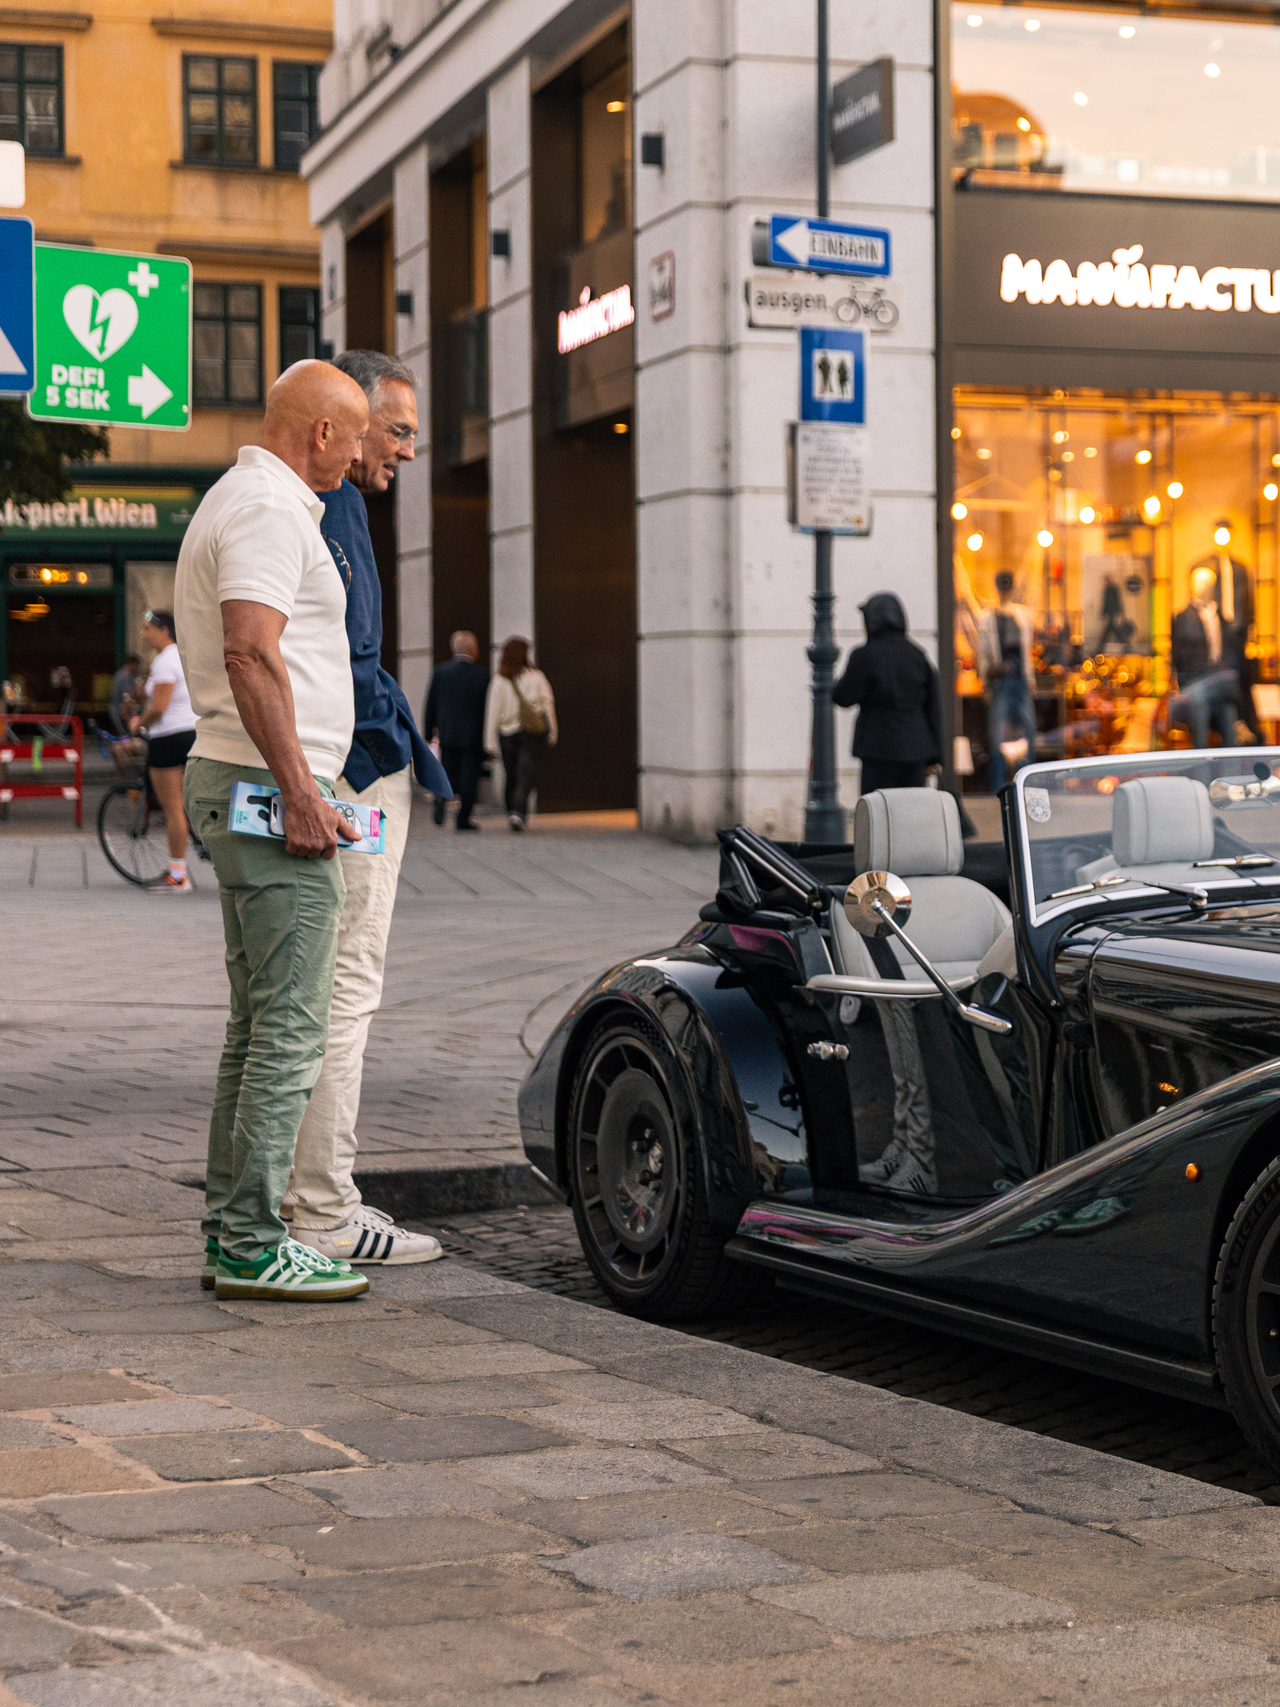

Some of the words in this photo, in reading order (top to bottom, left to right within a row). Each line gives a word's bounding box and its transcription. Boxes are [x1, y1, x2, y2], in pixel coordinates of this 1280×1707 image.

[811, 231, 880, 261] EINBAHN
[51, 363, 105, 389] DEFI
[46, 385, 61, 407] 5
[65, 387, 110, 411] SEK
